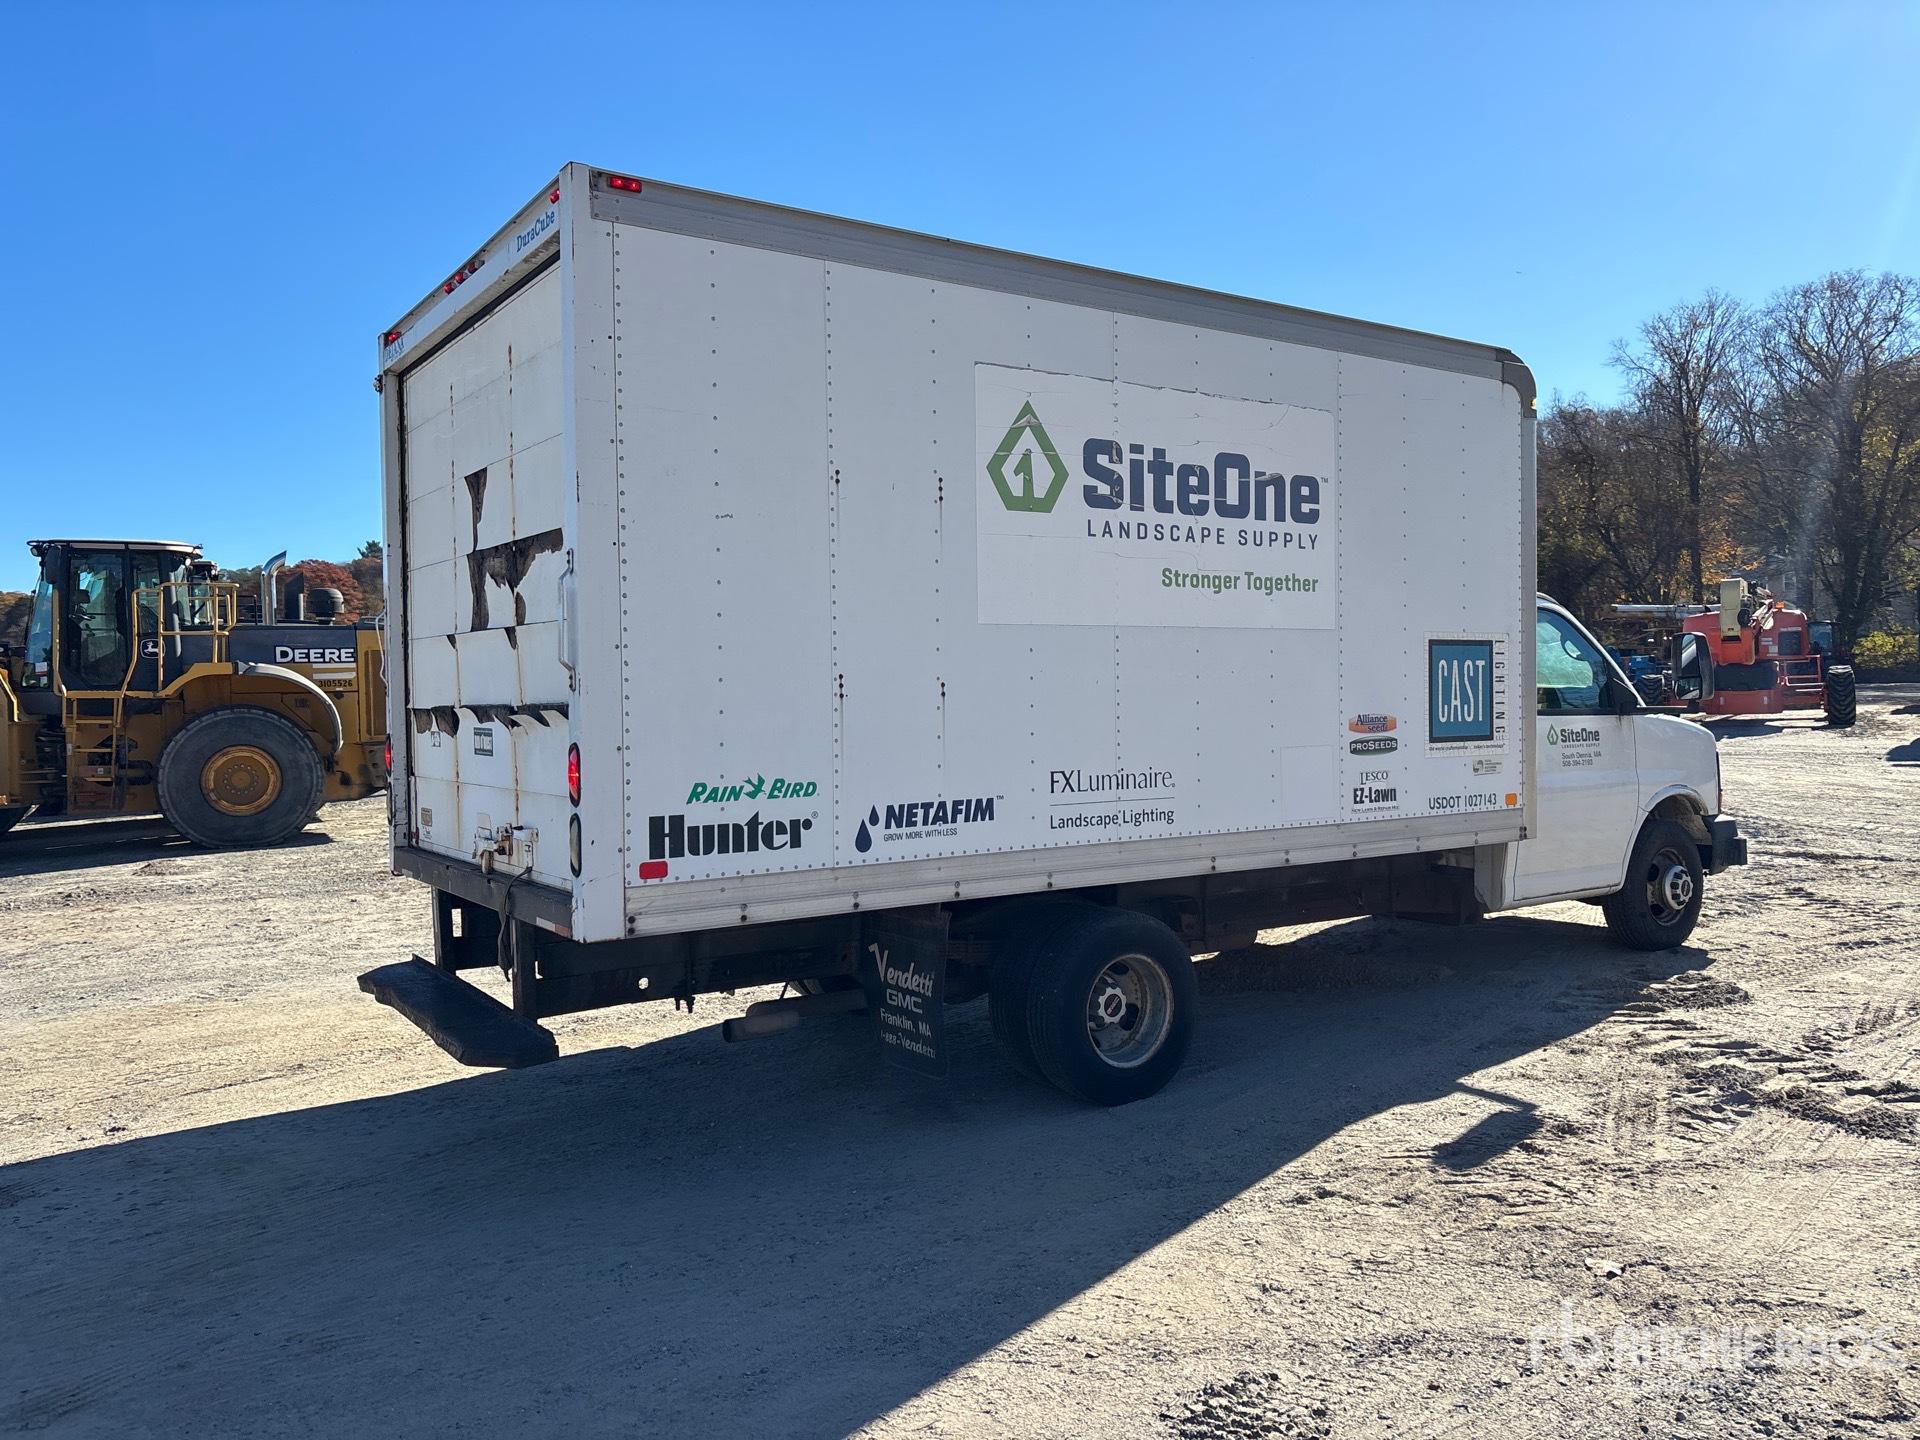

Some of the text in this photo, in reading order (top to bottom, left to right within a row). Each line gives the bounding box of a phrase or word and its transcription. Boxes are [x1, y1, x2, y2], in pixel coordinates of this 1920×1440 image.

[516, 211, 555, 253] DuraCube
[1082, 437, 1320, 524] SiteOne
[1087, 519, 1318, 550] LANDSCAPE SUPPLY
[1161, 568, 1318, 596] Stronger Together
[275, 646, 355, 663] DEERE
[1438, 659, 1486, 723] CAST
[1494, 640, 1506, 733] LIGHTING
[1356, 714, 1388, 726] Alliance
[1367, 724, 1385, 732] seed
[1351, 741, 1397, 751] PROSEEDS
[1560, 728, 1600, 743] SiteOne
[686, 778, 817, 804] RAIN BIRD
[1360, 771, 1389, 785] LESCO
[1353, 787, 1397, 804] EZ-Lawn
[1428, 793, 1497, 810] USDOT 1027143
[884, 797, 995, 829] NETAFIM
[1050, 808, 1174, 829] Landscape Lighting
[648, 810, 813, 860] Hunter
[883, 828, 958, 842] GROW MORE WITH LESS
[868, 942, 935, 998] Vendetti
[886, 988, 923, 1015] GMC
[880, 1007, 932, 1039] Franklin, MA
